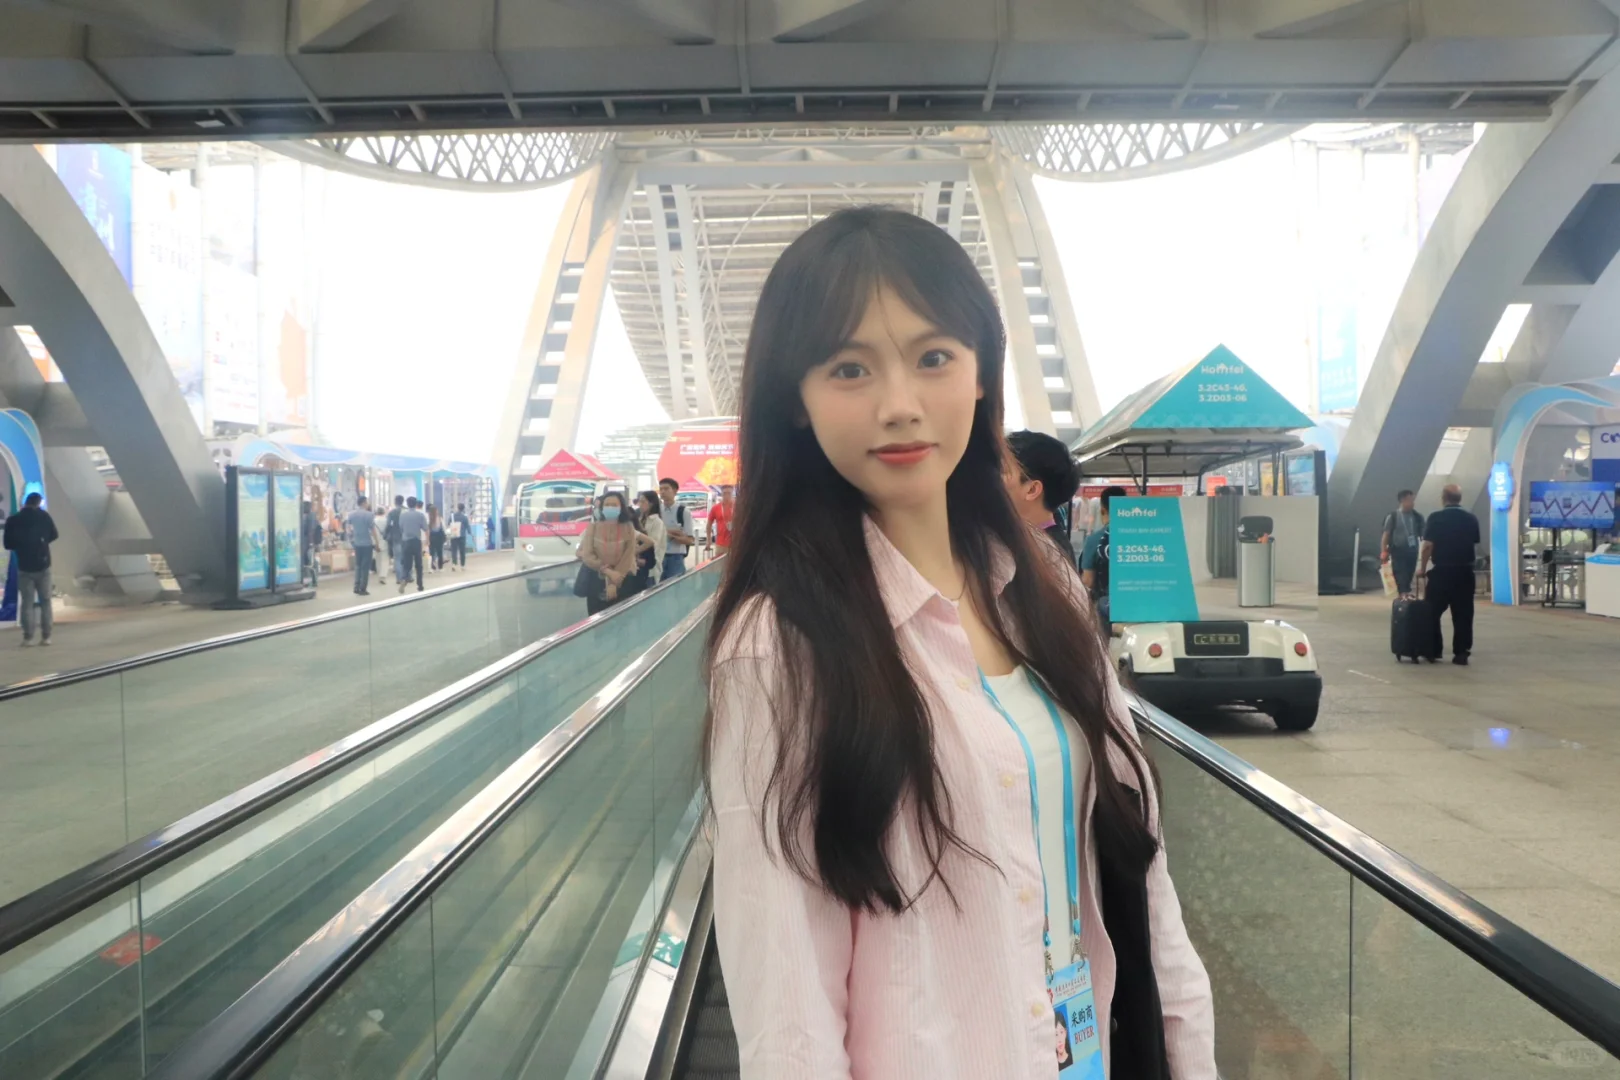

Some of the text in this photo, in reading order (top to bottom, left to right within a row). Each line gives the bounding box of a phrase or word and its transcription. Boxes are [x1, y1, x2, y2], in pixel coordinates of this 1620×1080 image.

[1071, 1004, 1093, 1028] 采购商
[1074, 1025, 1094, 1045] BUYER
